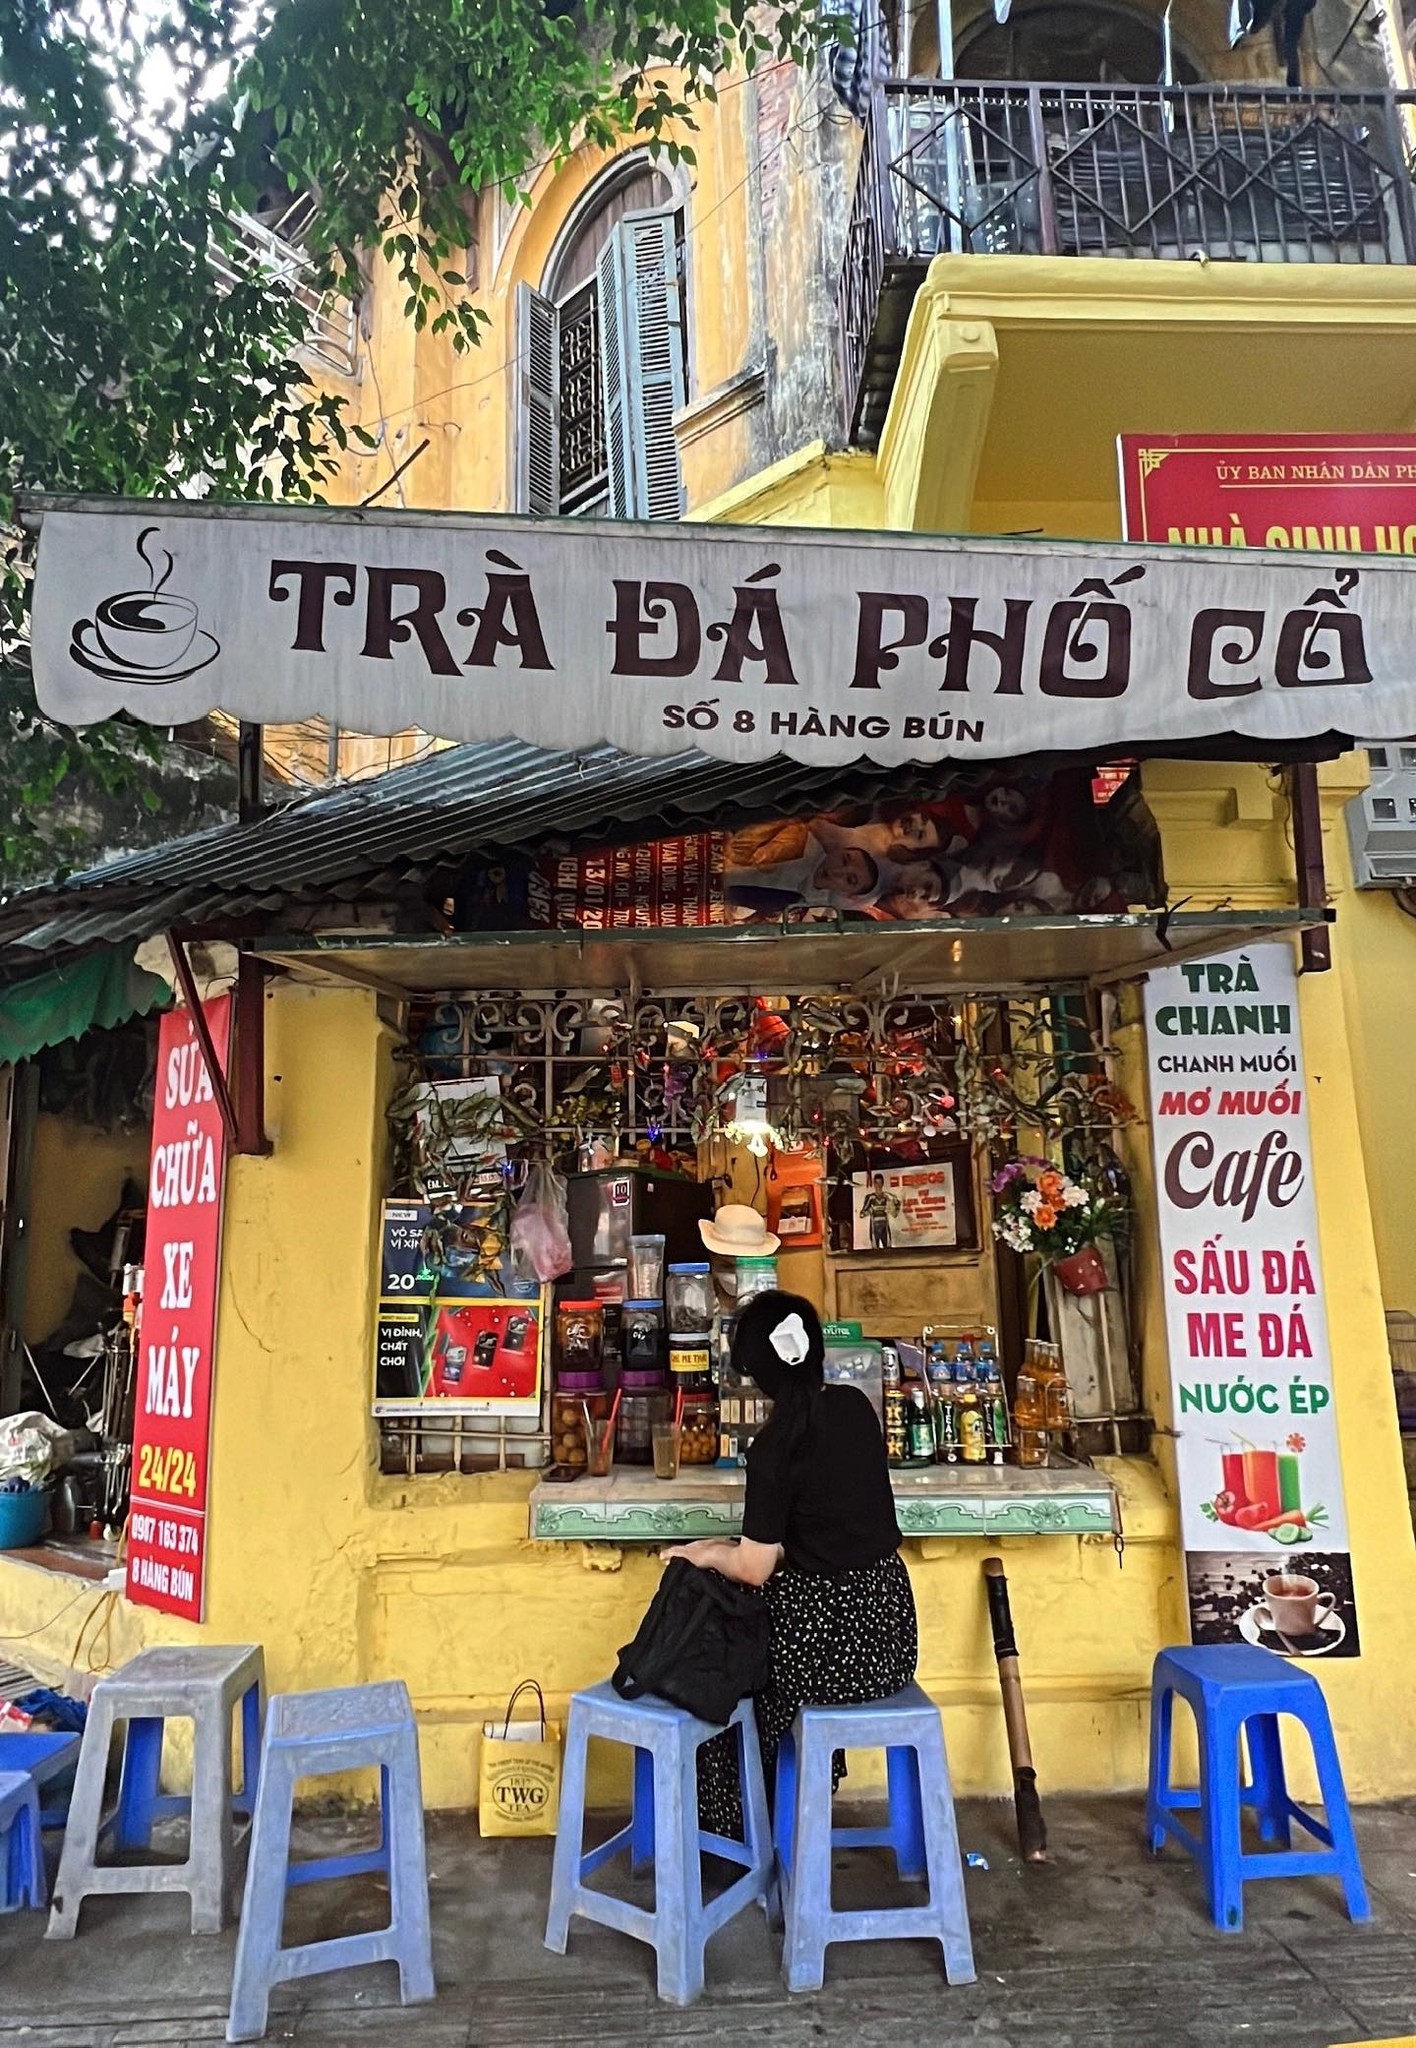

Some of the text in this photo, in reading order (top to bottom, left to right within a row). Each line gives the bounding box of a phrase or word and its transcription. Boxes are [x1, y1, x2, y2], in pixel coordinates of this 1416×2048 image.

[1216, 459, 1242, 480] ỦY
[1248, 464, 1285, 480] BAN
[1351, 460, 1390, 479] DÂN
[269, 549, 1373, 700] TRÀ ĐÁ PHỐ CỔ
[663, 697, 984, 742] SỐ 8 HÀNG BÚN
[1181, 954, 1259, 993] TRÀ
[1155, 1004, 1291, 1036] CHANH
[1157, 1046, 1298, 1074] CHANH MUỐI
[1159, 1077, 1302, 1116] MƠ MUỐI
[151, 1119, 217, 1209] CHỮA
[1164, 1129, 1305, 1223] Cafe
[160, 1240, 194, 1310] XE
[387, 1274, 415, 1290] 20
[1173, 1234, 1316, 1296] SẤU ĐÁ
[1187, 1303, 1313, 1359] ME ĐÁ
[145, 1325, 200, 1419] MÁY
[1179, 1374, 1330, 1415] NƯỚC ÉP
[138, 1444, 197, 1498] 24/24
[131, 1555, 194, 1603] 8 HÀNG BÚN
[496, 1787, 544, 1804] TWG
